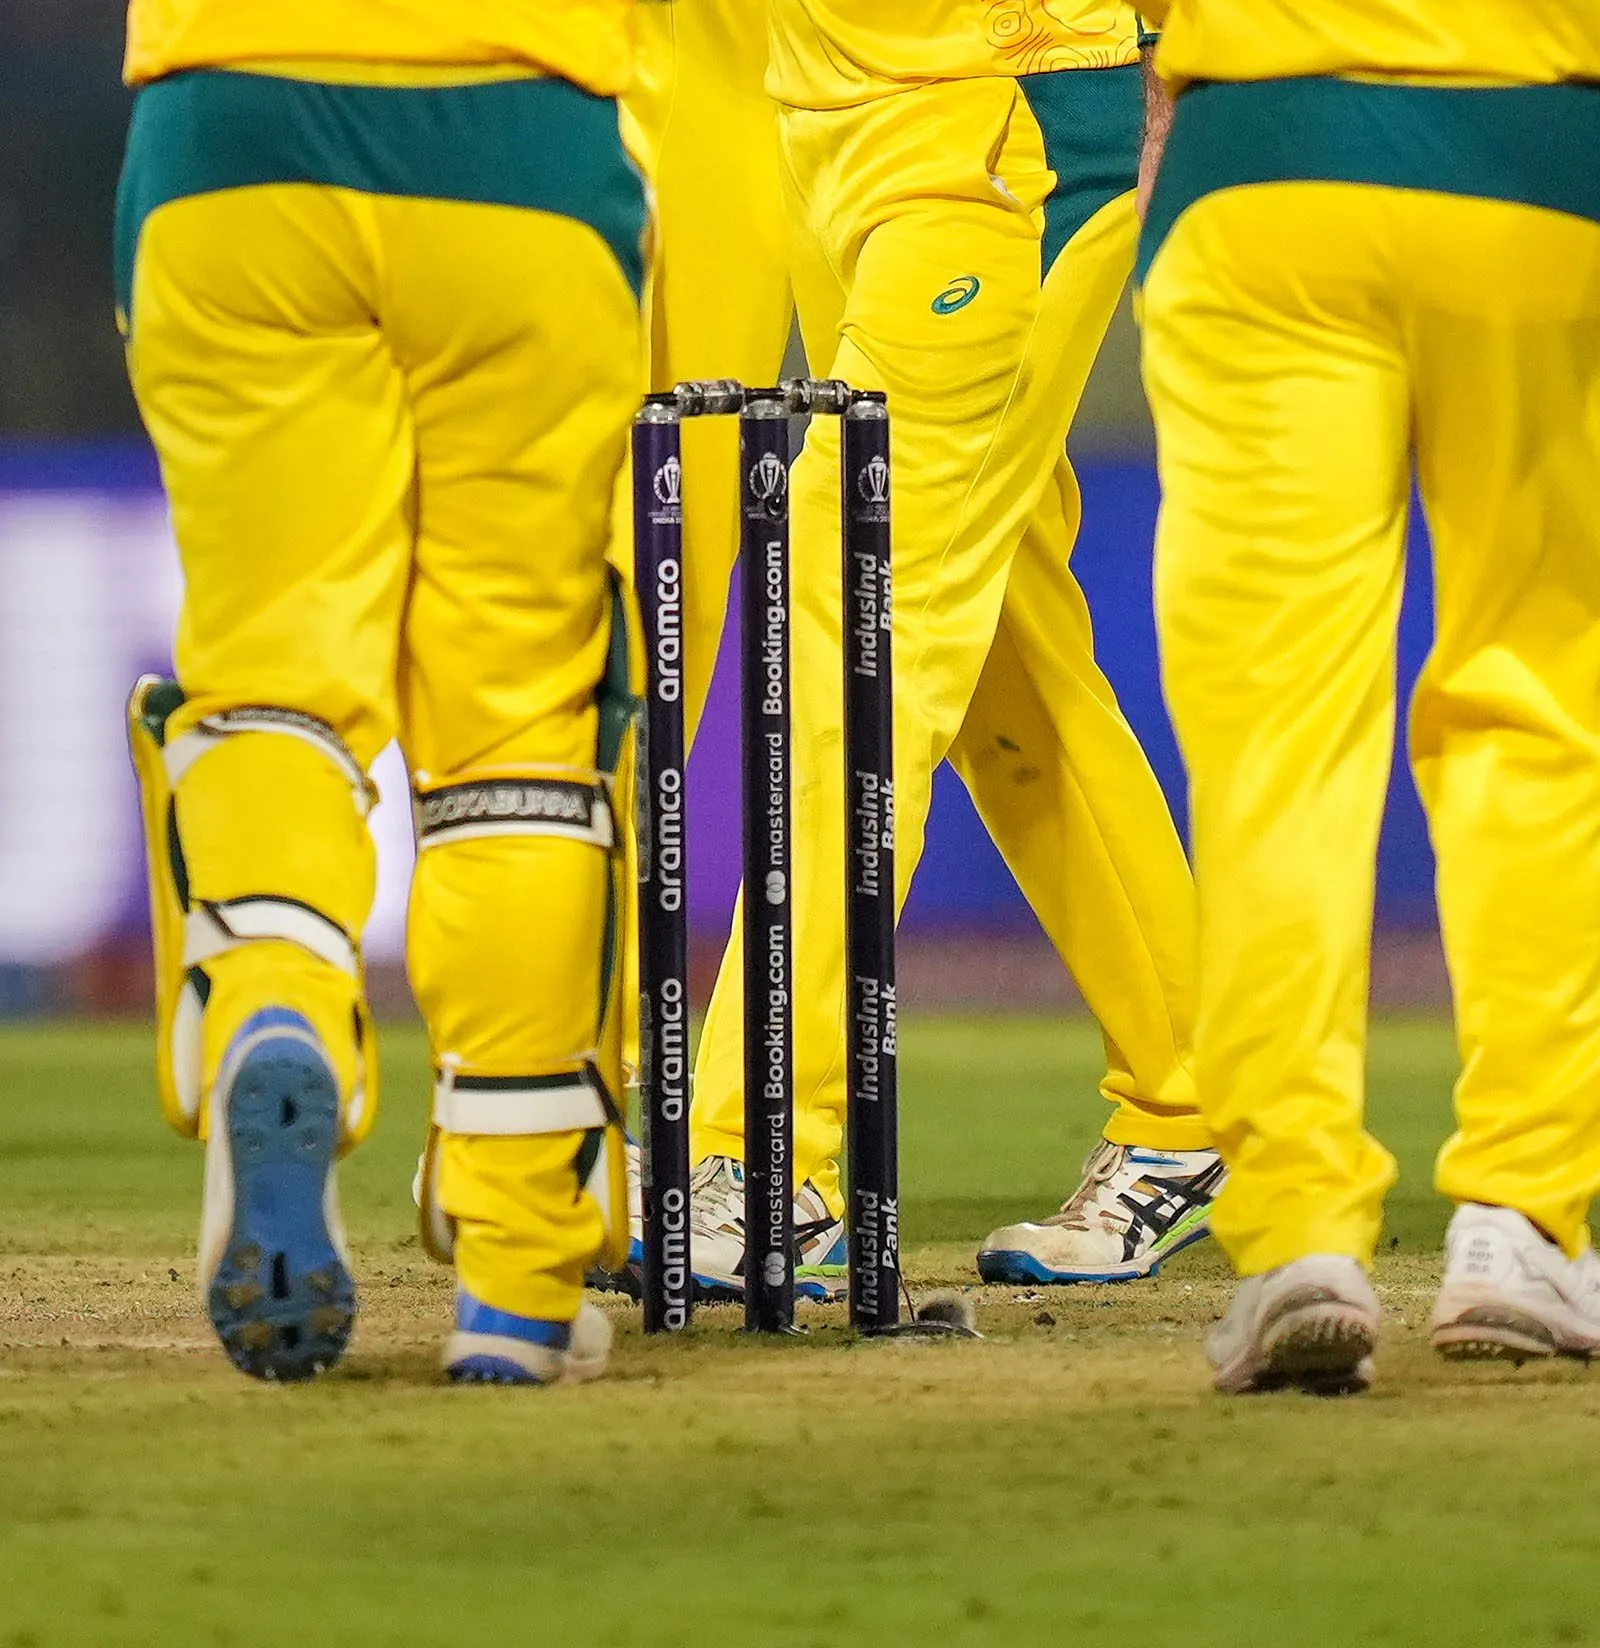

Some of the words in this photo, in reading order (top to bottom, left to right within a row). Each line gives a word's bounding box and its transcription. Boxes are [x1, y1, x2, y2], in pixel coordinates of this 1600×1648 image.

[657, 558, 680, 702] aramco
[762, 540, 786, 716] Booking.com
[854, 551, 878, 678] IndusInd
[658, 767, 681, 912] aramco
[765, 733, 783, 866] mastercard
[856, 769, 879, 898] IndusInd
[660, 977, 683, 1122] aramco
[764, 924, 788, 1100] Booking.com
[856, 975, 879, 1102] IndusInd
[766, 1112, 785, 1247] mastercard
[662, 1187, 686, 1331] aramco
